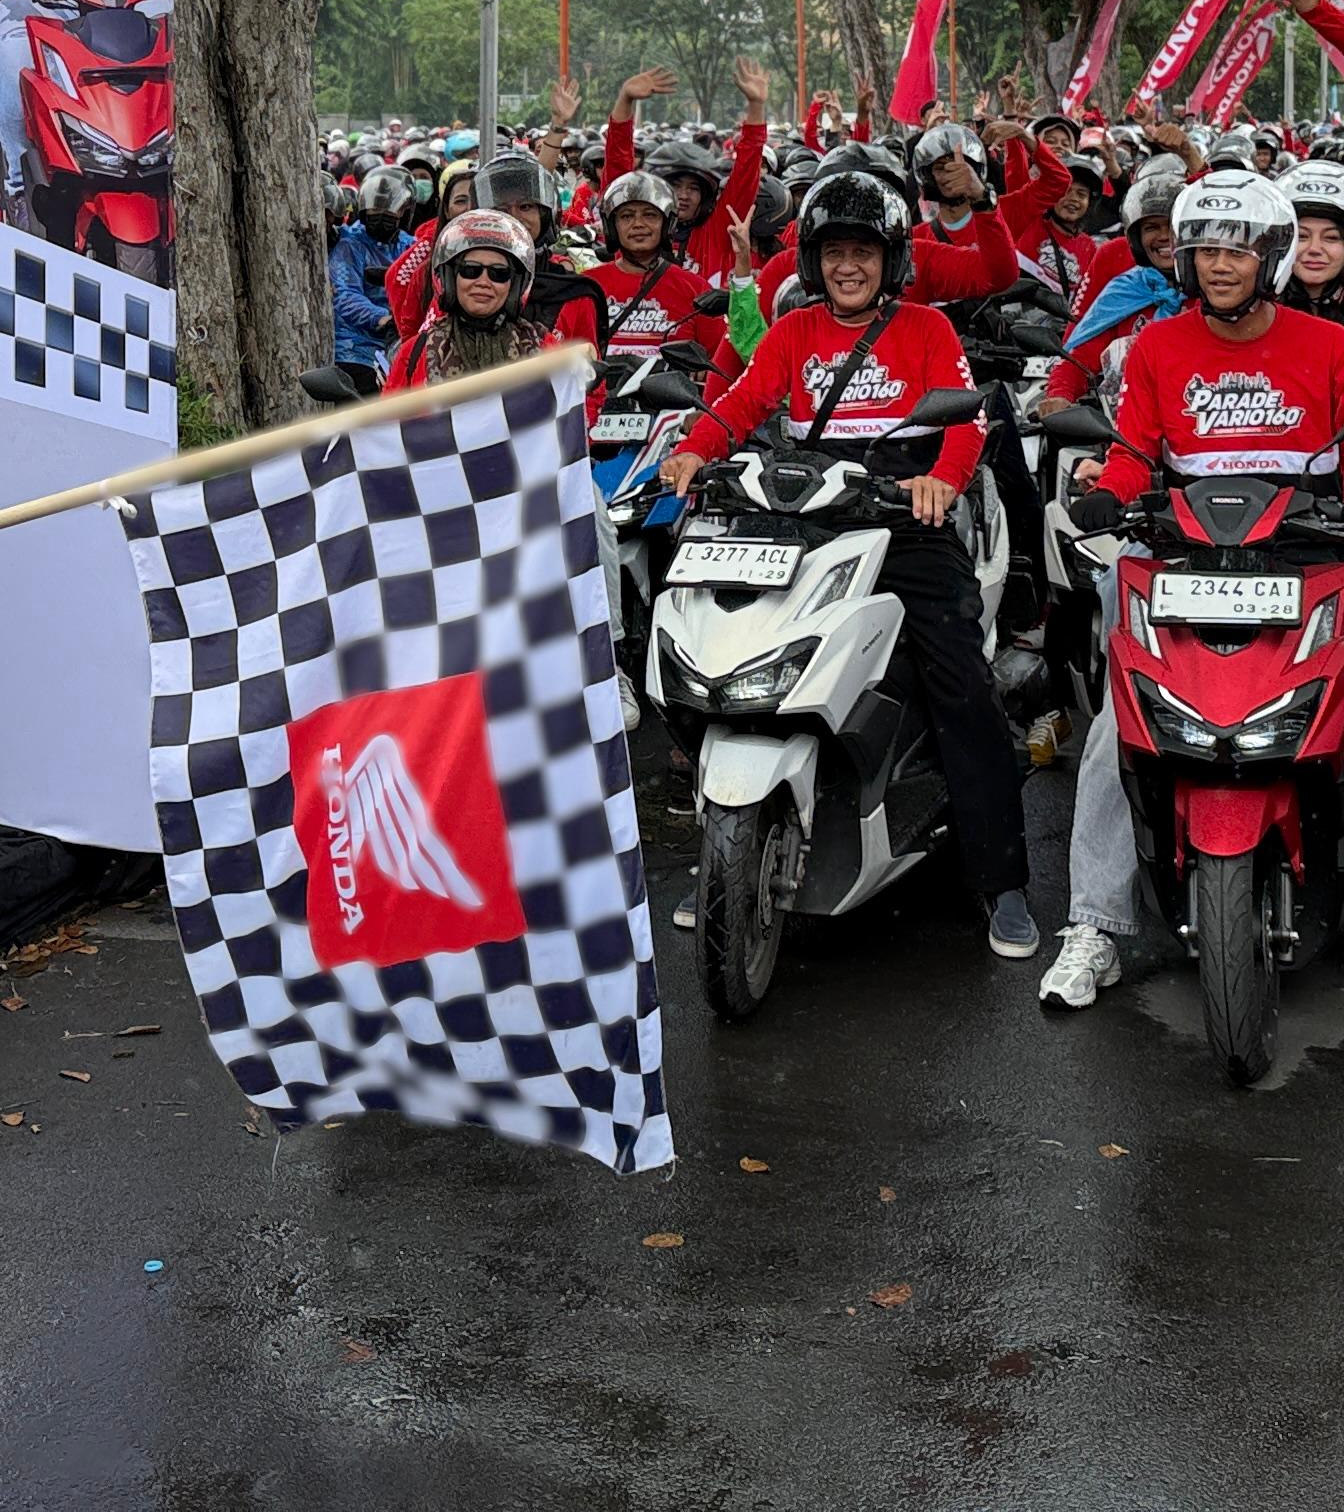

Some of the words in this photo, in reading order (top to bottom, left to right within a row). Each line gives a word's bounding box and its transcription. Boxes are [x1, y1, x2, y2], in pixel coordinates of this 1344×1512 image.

[807, 367, 886, 389] PAADE
[813, 382, 903, 410] VRIO160
[1190, 389, 1281, 411] PARADE
[833, 424, 884, 434] HONDA
[1198, 408, 1301, 435] VARIO160
[1222, 460, 1282, 470] HONDA
[1211, 497, 1244, 505] HONDA
[685, 546, 694, 561] L
[701, 546, 748, 563] 3277
[755, 548, 789, 565] ACL
[1161, 579, 1174, 596] L
[1190, 579, 1244, 597] 2344
[1254, 581, 1294, 597] CAI
[320, 742, 365, 935] HONDA
